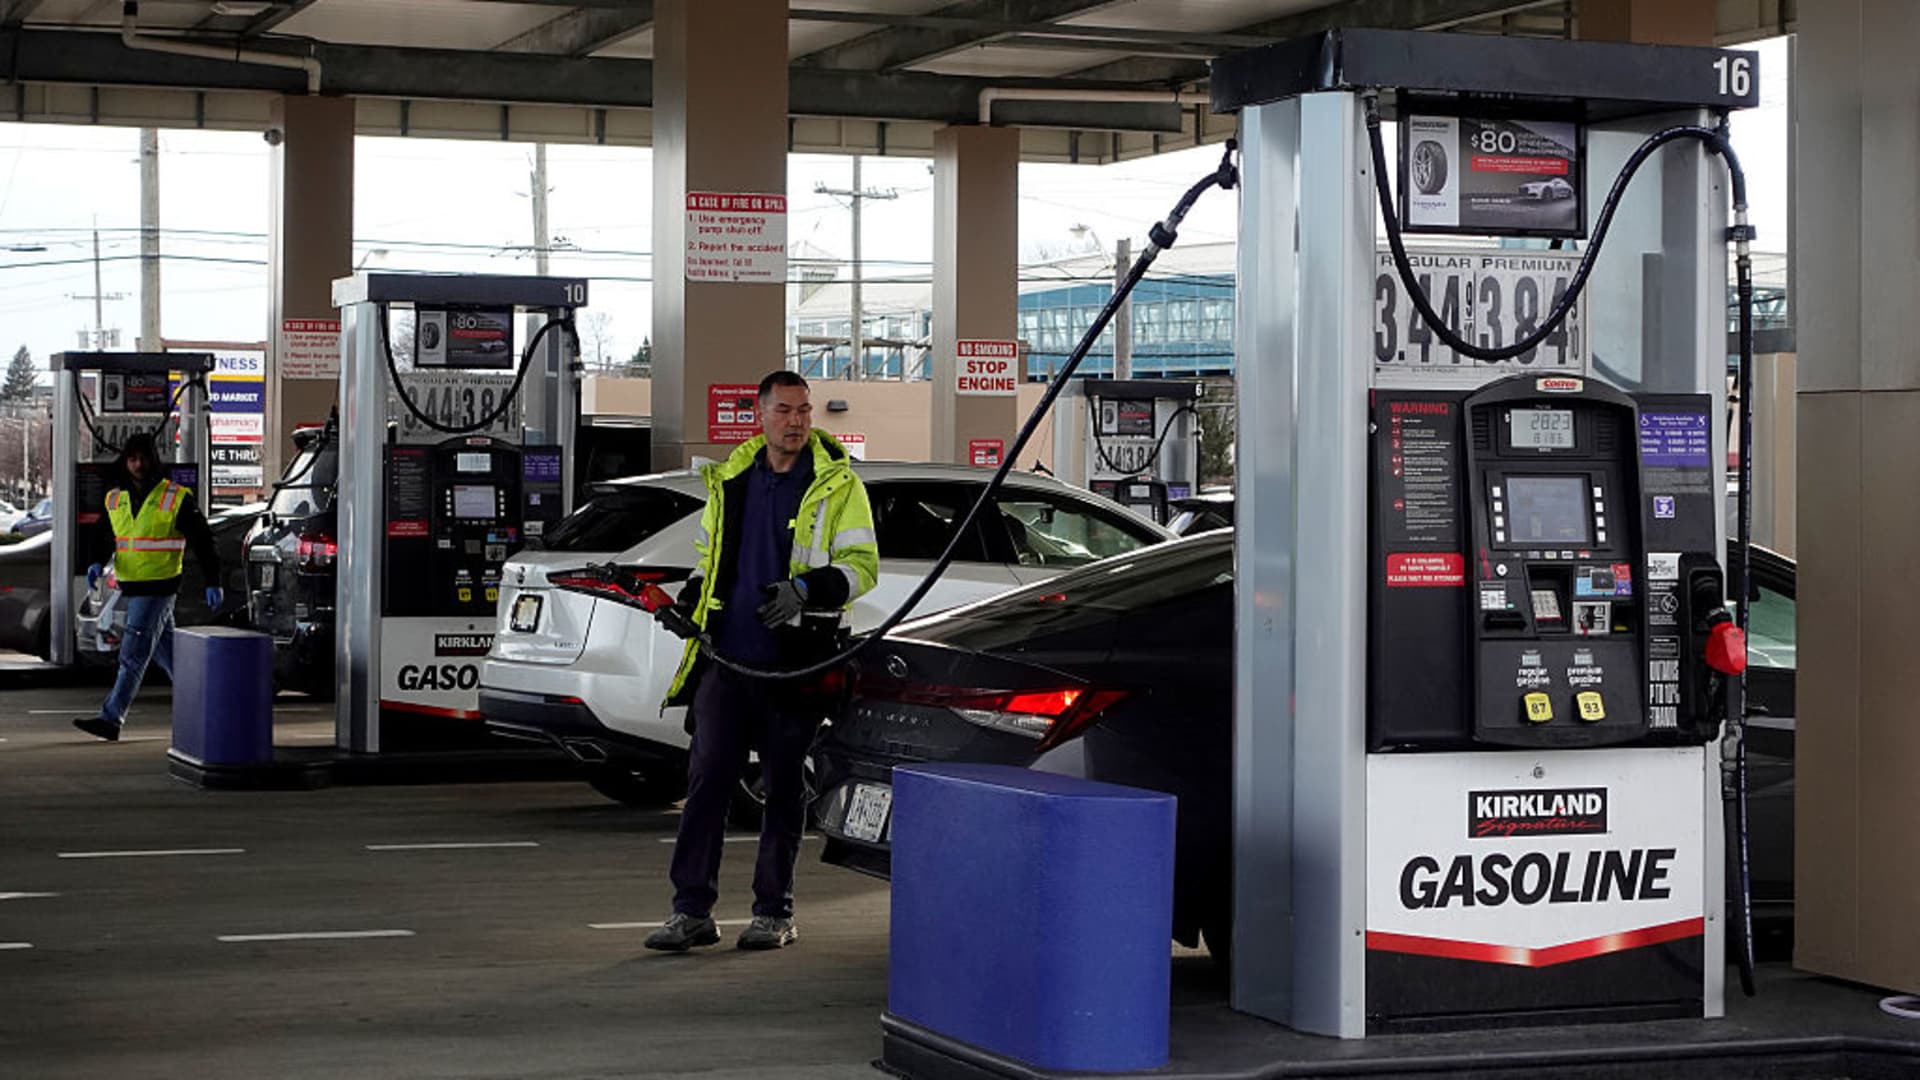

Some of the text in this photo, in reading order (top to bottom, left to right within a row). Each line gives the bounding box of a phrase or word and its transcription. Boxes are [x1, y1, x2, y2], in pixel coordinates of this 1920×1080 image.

[1713, 57, 1750, 96] 16
[1471, 130, 1516, 152] $80
[699, 214, 715, 222] Use
[719, 216, 766, 225] emergency
[699, 241, 727, 252] Report
[731, 243, 743, 252] the
[748, 244, 784, 252] accident
[1482, 258, 1572, 271] PREMIUM
[564, 284, 583, 303] 10
[1479, 275, 1568, 364] 384
[960, 343, 1013, 356] NO SMOKING
[204, 356, 211, 368] 4
[215, 357, 258, 370] NESS
[967, 360, 1007, 374] STOP
[958, 377, 1015, 391] ENGINE
[1195, 384, 1203, 397] 6
[221, 392, 258, 402] MARKET
[463, 387, 509, 432] 384
[1391, 401, 1449, 416] WARNING
[229, 450, 258, 460] THRU
[438, 637, 495, 649] KIRKLAN
[398, 664, 480, 690] GASO
[1518, 667, 1548, 678] regular
[1567, 665, 1603, 677] premium
[1516, 677, 1550, 688] gasoline
[1569, 676, 1602, 687] gasoline
[1531, 702, 1546, 714] 87
[1583, 702, 1600, 713] 93
[1476, 793, 1602, 818] KIRKLAND
[1476, 817, 1602, 838] Signature
[1399, 848, 1677, 910] GASOLINE
